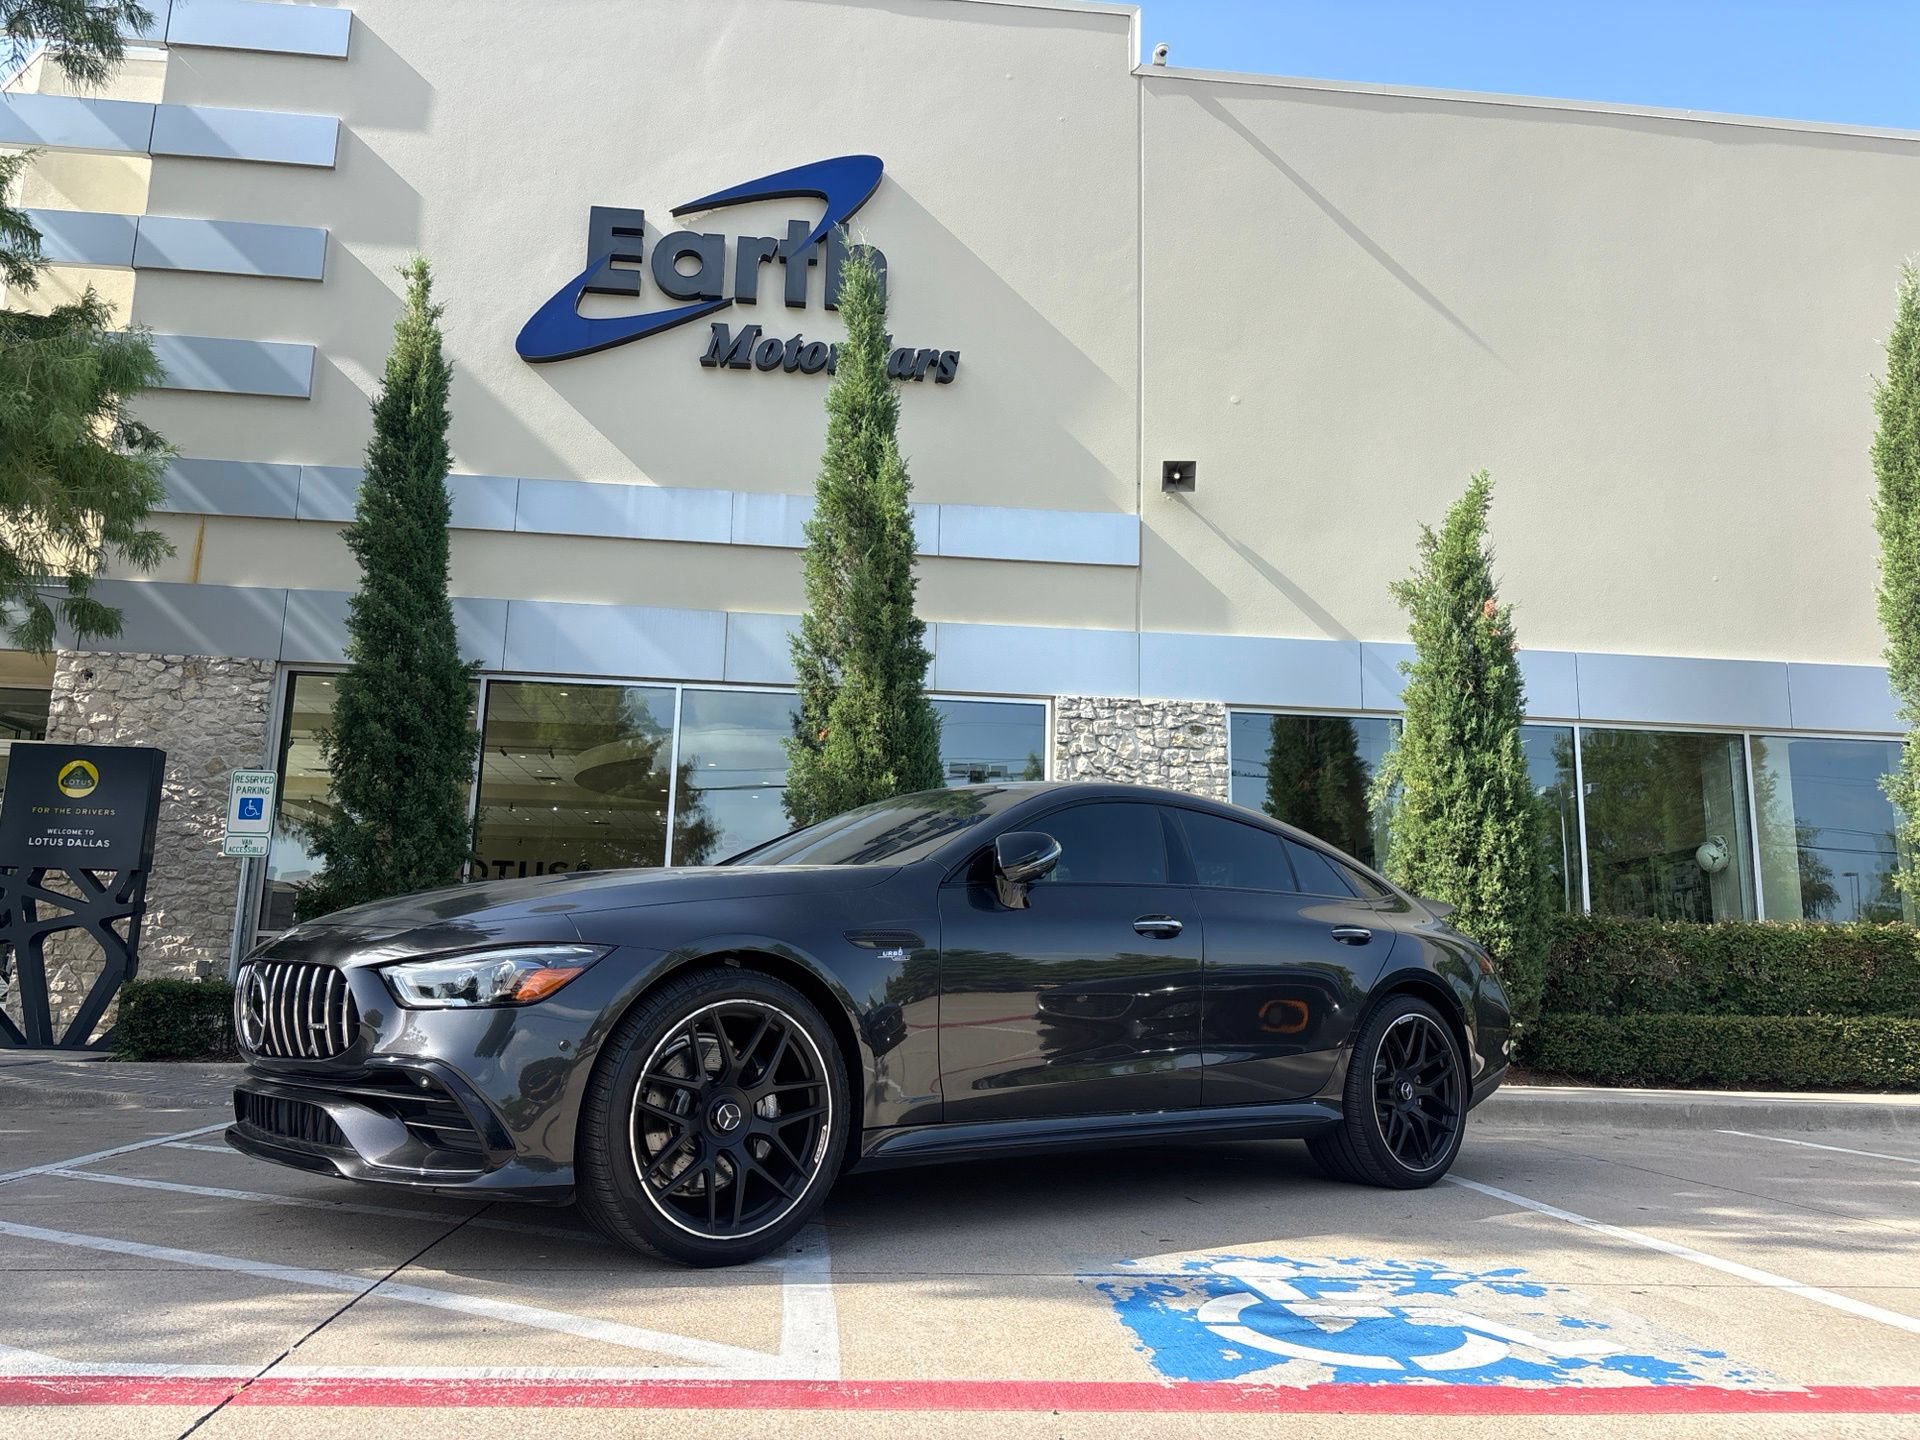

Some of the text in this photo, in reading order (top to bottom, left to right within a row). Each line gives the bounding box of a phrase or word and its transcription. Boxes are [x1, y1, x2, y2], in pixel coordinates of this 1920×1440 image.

[585, 205, 888, 314] Earth
[700, 322, 961, 385] Motoars
[63, 778, 93, 787] LOTUS
[234, 775, 274, 784] RESERVED
[235, 786, 270, 795] PARKING
[31, 806, 116, 816] FOR THE DRIVERS
[47, 828, 83, 836] WELCOME
[28, 837, 110, 848] LOTUS DALLAS
[241, 838, 253, 846] VAN
[227, 846, 264, 854] ACCESSIBLE
